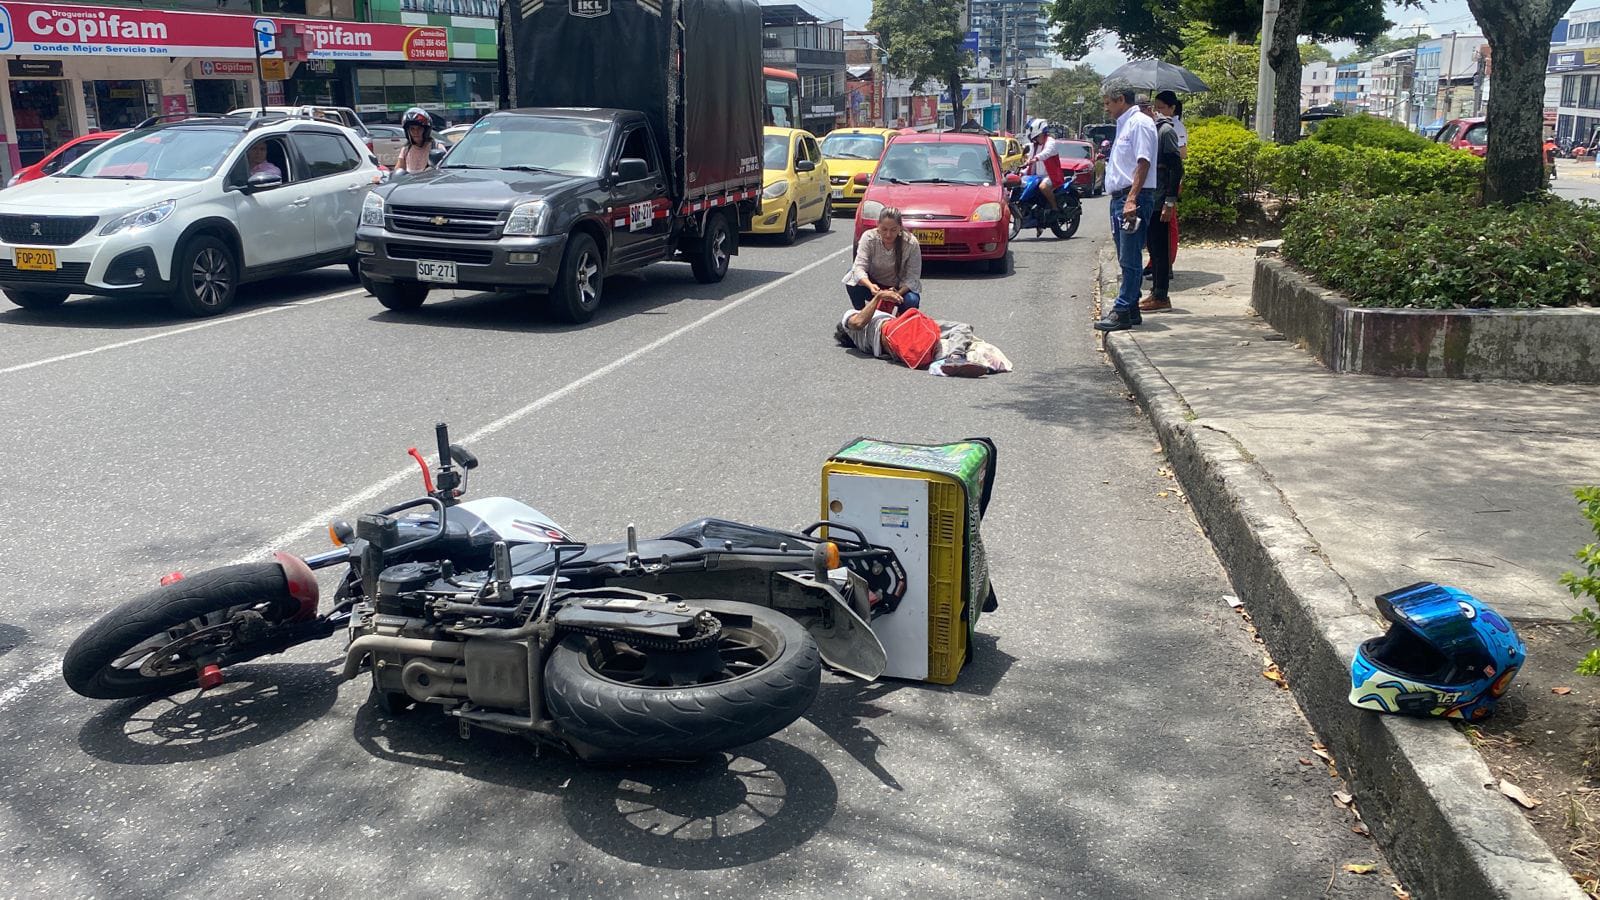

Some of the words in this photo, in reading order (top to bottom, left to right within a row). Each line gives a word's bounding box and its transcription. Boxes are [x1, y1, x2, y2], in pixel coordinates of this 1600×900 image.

[51, 9, 98, 19] Droguerias
[27, 10, 168, 43] Copifam
[305, 24, 372, 49] opifam
[33, 43, 70, 52] Donde
[72, 44, 102, 54] Mejor
[105, 45, 147, 54] Servicio
[149, 46, 168, 54] Dan
[214, 62, 253, 73] Copifam
